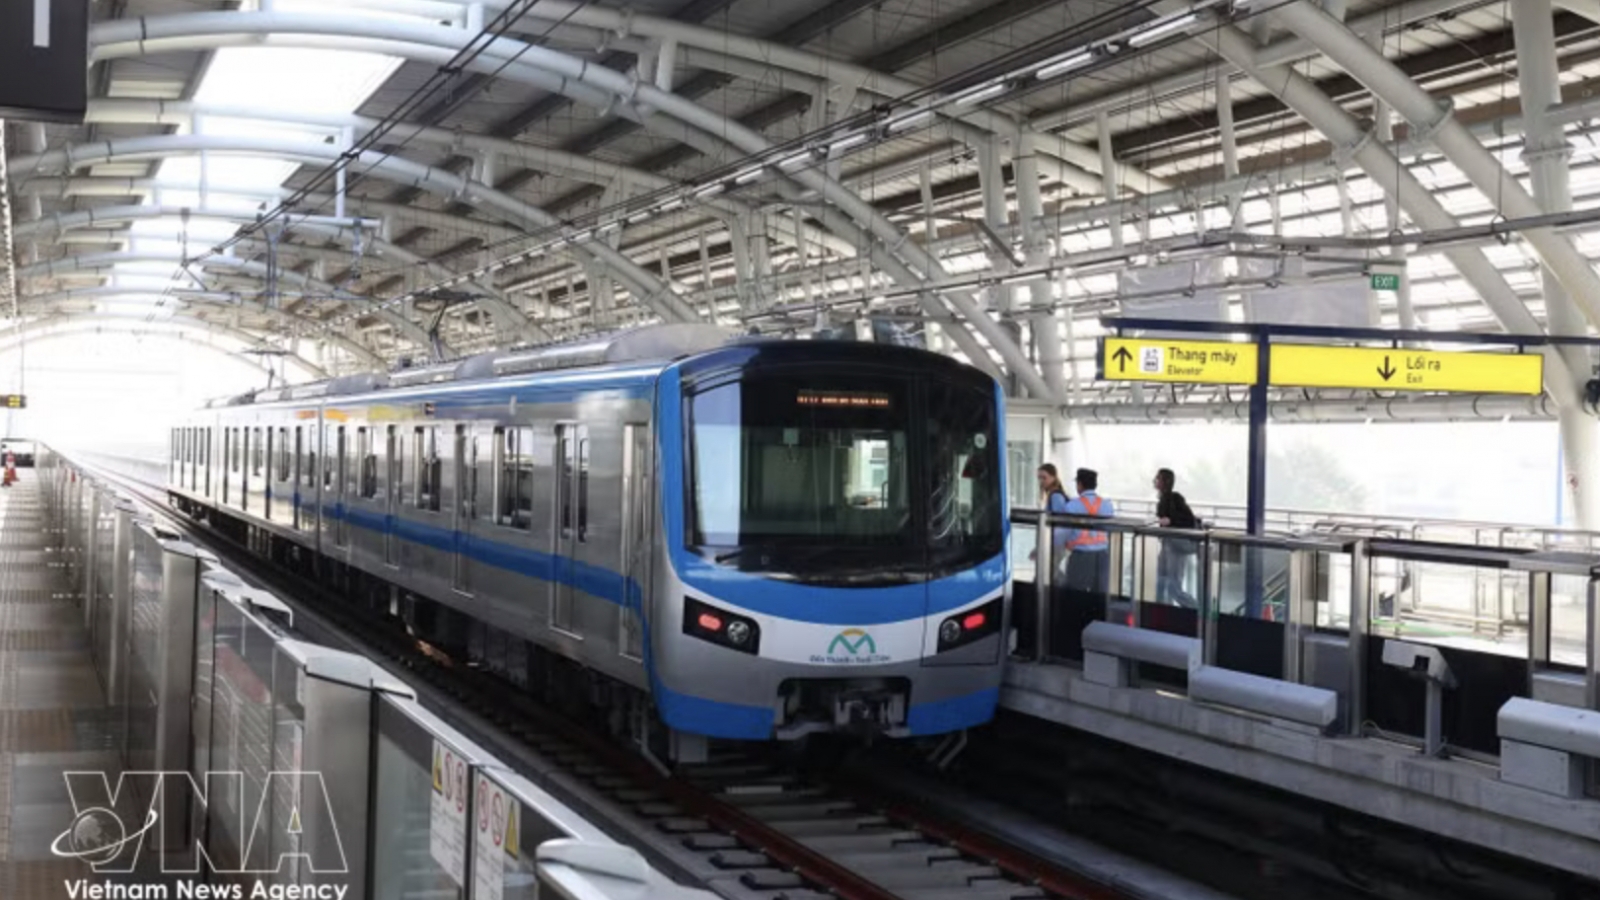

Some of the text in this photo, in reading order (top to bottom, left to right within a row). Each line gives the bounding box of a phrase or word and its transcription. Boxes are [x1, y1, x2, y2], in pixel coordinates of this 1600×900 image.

[1374, 275, 1394, 288] EXIT
[1168, 347, 1238, 366] Thang máy
[1167, 365, 1204, 376] Elevator
[1428, 360, 1441, 371] ra
[1406, 372, 1423, 384] Exit
